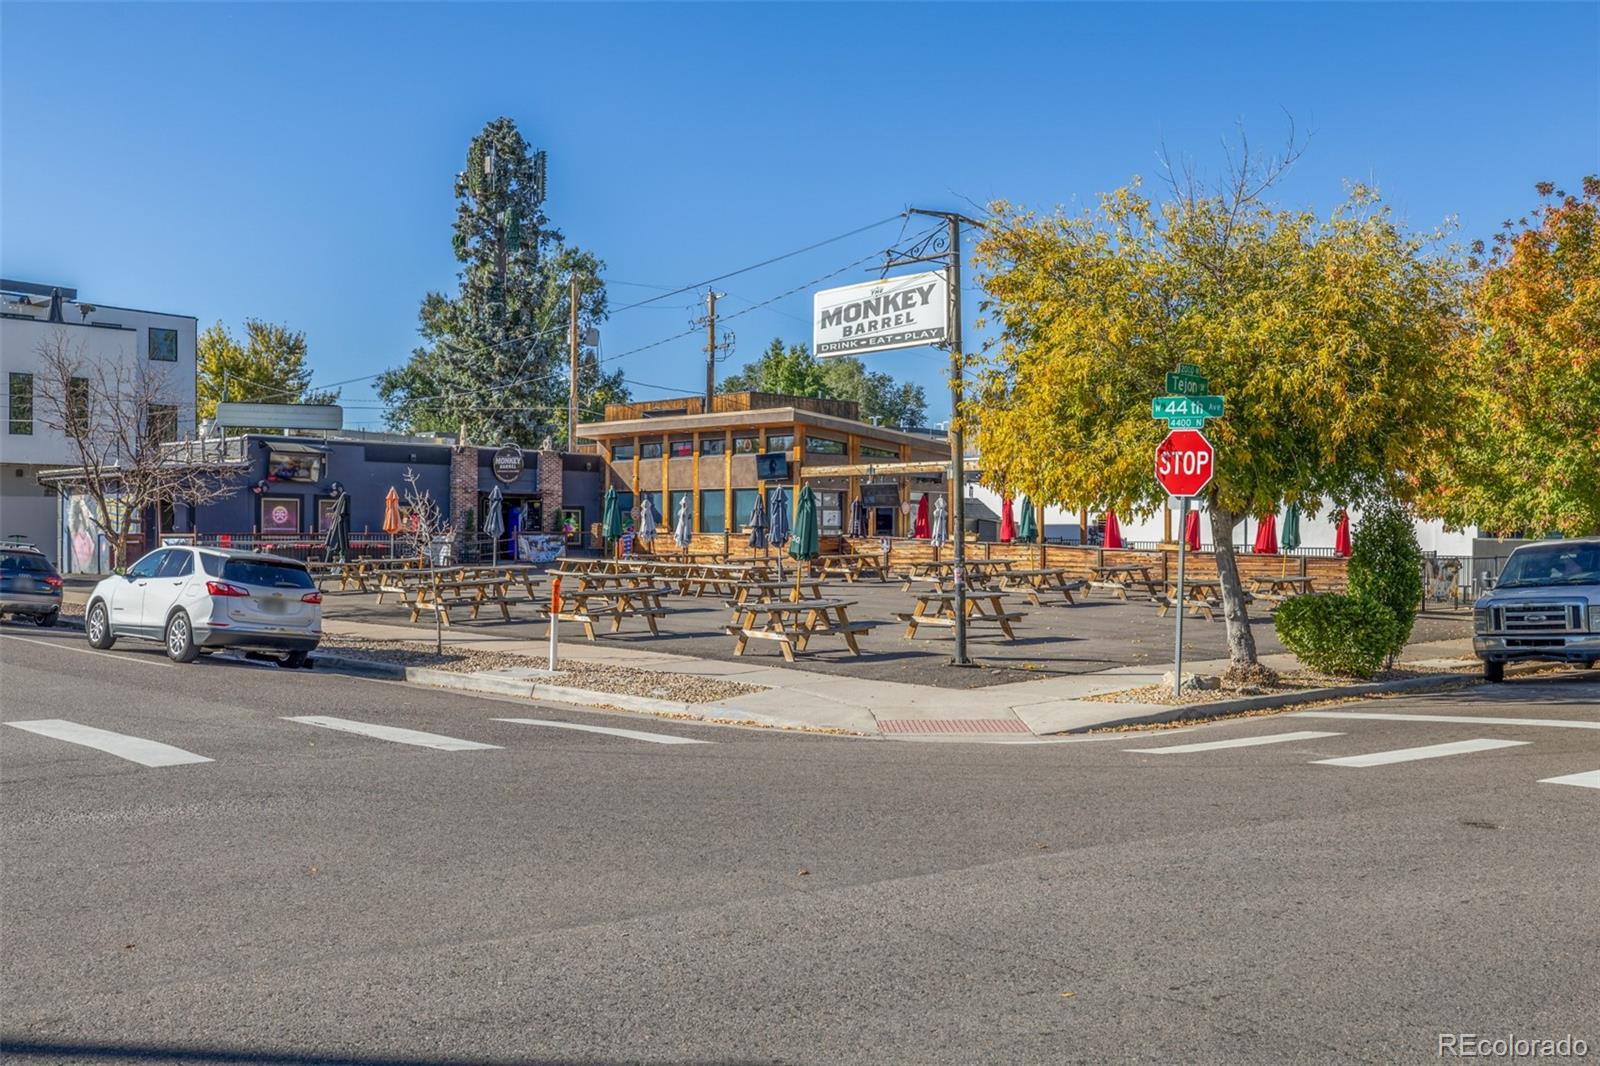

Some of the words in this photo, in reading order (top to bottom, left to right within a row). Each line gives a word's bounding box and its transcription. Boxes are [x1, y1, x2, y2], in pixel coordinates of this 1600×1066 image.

[820, 283, 936, 329] MONKEY
[842, 312, 914, 337] BARREL
[821, 341, 858, 352] DRINK
[869, 335, 893, 345] EAT
[904, 329, 938, 340] PLAY
[1172, 376, 1198, 394] Tejon
[1165, 400, 1204, 415] 44th
[1170, 419, 1192, 427] 4400
[1195, 419, 1202, 427] N
[1159, 451, 1209, 475] STOP
